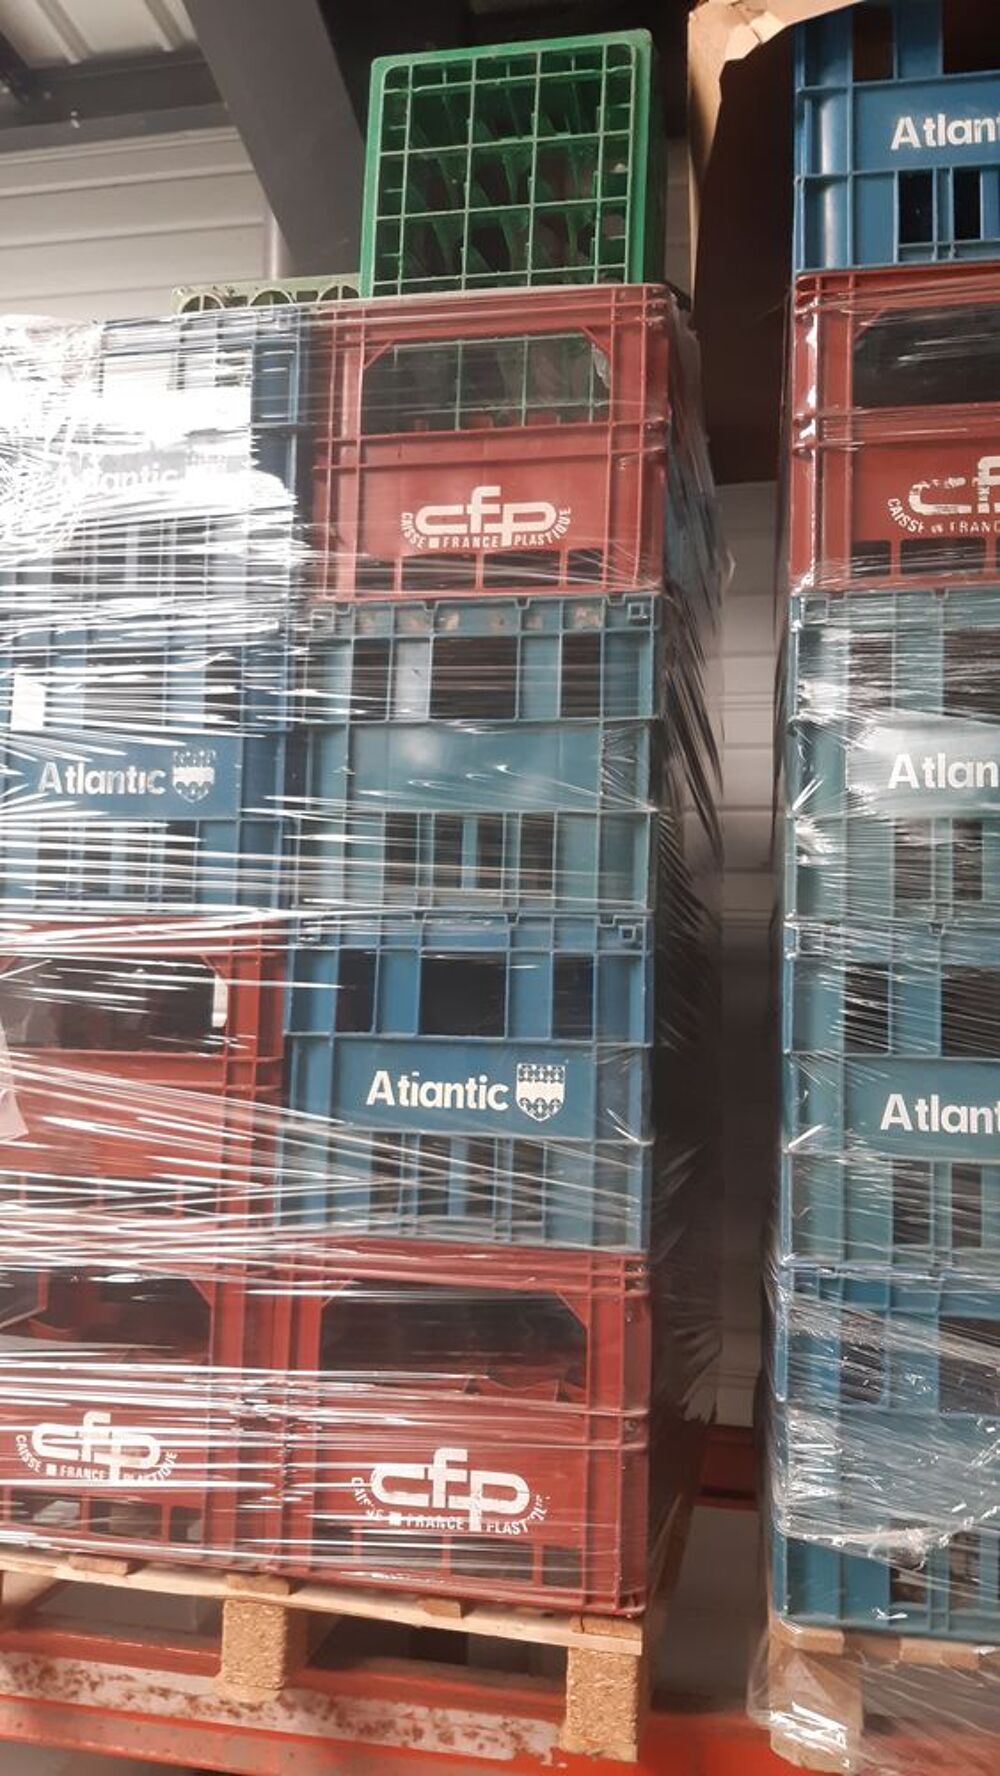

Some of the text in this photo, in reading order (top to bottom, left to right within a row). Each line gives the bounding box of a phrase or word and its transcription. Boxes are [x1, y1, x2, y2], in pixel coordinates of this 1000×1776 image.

[400, 506, 572, 549] CAISSE FRANCE PLASTIQUE
[414, 485, 557, 546] cfp
[37, 760, 167, 796] Atlantic
[15, 1433, 43, 1474] CAISSE
[60, 1464, 107, 1481] FRANCE
[31, 1410, 161, 1482] cfp
[370, 1447, 530, 1532] cfp
